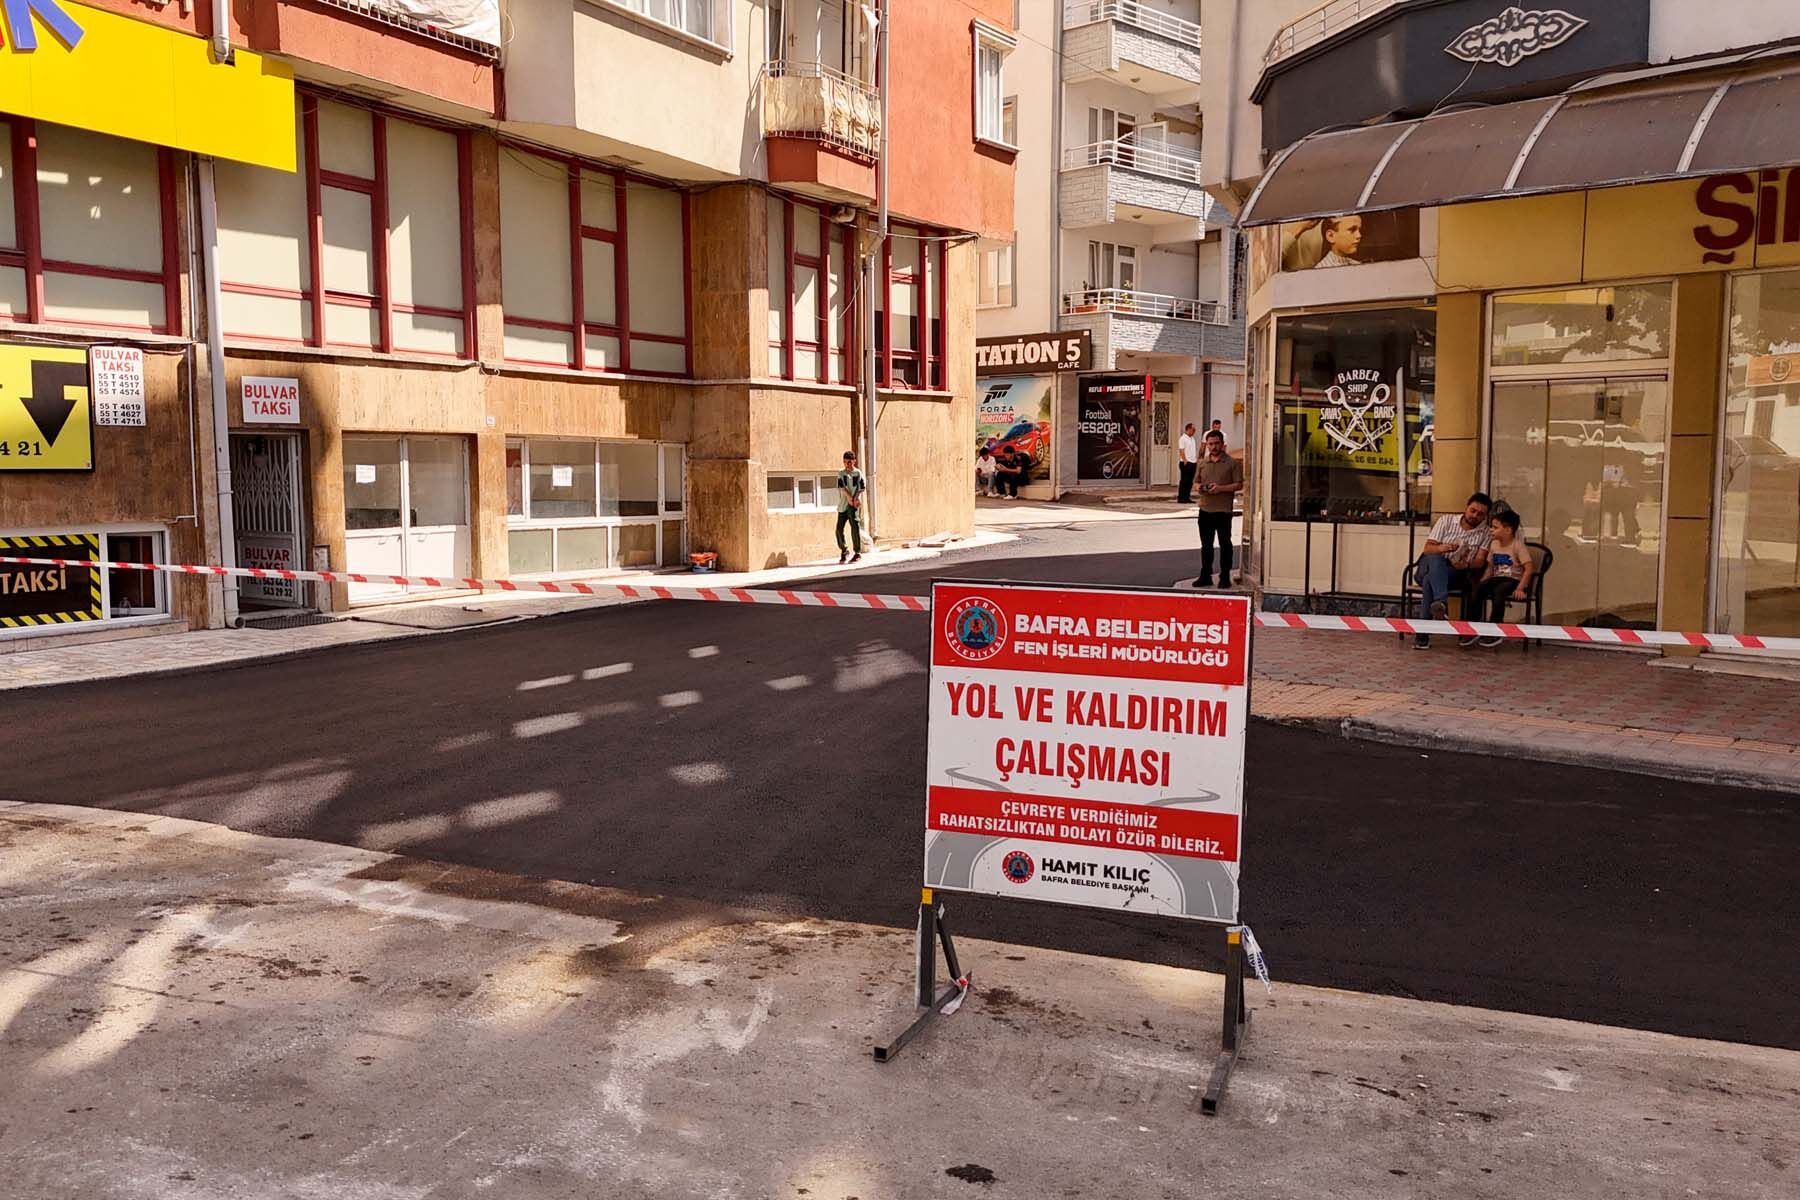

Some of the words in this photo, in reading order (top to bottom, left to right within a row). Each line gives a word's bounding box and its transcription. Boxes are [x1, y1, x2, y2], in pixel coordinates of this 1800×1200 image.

[95, 349, 139, 361] BULVAR
[1066, 338, 1081, 361] 5
[1057, 361, 1080, 369] CAFE
[1337, 369, 1380, 384] BARBER
[244, 384, 297, 400] BULVAR
[1347, 383, 1369, 393] SHOP
[980, 405, 1014, 413] FORZA
[1085, 409, 1112, 420] Football
[18, 441, 42, 456] 21
[245, 548, 290, 561] BULVAR
[957, 600, 997, 615] BAFRA
[1015, 614, 1091, 636] BAFRA
[1095, 617, 1230, 645] BELEDİYESİ
[1013, 641, 1049, 656] FEN
[1052, 640, 1107, 659] İŞLERİ
[1111, 644, 1229, 667] MÜDÜRLÜĞÜ
[946, 682, 1004, 719] YOL
[1014, 686, 1054, 723] VE
[1066, 690, 1228, 737] KALDIRIM
[995, 737, 1171, 789] ÇALIŞMASI
[1001, 800, 1066, 819] ÇEVREYE
[1070, 807, 1158, 829] VERDİĞİMİZ
[940, 813, 1055, 837] RAHATSIZLIKTAN
[1060, 824, 1111, 843] DOLAYI
[1116, 828, 1156, 848] ÖZÜR
[1161, 833, 1225, 855] DİLERİZ.
[1104, 865, 1151, 884] KILIÇ
[1041, 875, 1069, 885] BAFRA
[1112, 883, 1150, 894] BAŞKANI
